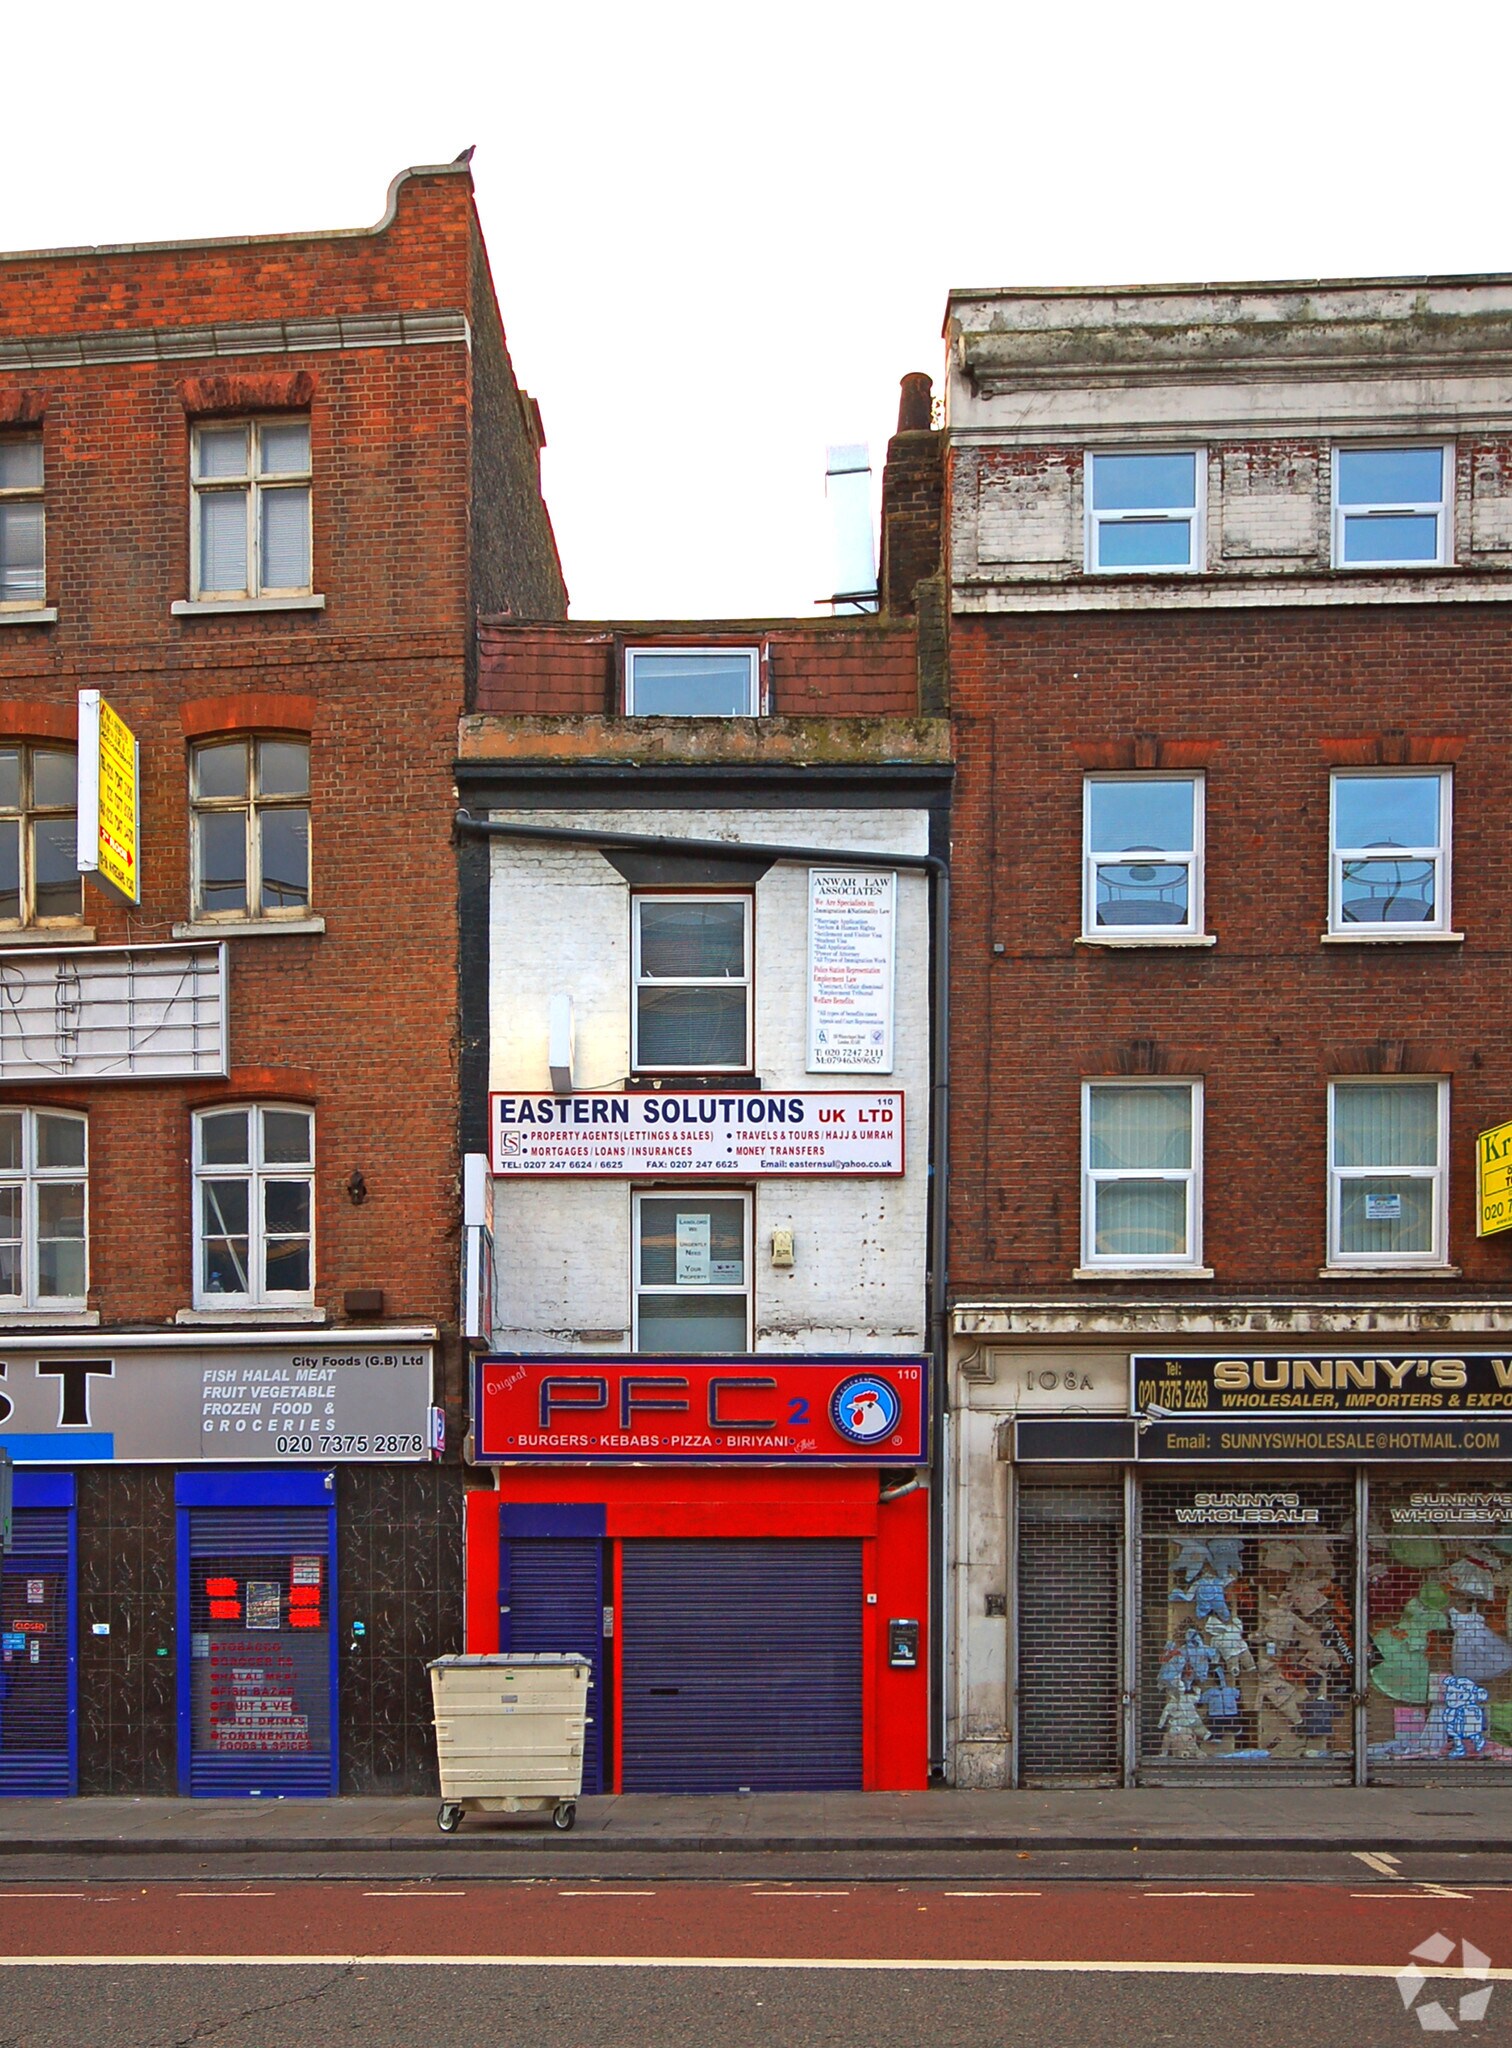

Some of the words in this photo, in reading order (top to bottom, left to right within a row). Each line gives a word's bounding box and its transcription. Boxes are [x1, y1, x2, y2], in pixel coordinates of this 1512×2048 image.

[814, 878, 856, 887] ANWAR
[865, 878, 890, 887] LAW
[819, 887, 883, 895] ASSOCIATES
[825, 1049, 840, 1057] 020
[842, 1049, 862, 1057] 7247
[864, 1049, 883, 1057] 2111
[878, 1098, 893, 1106] 110
[500, 1099, 629, 1123] EASTERN
[643, 1098, 805, 1123] SOLUTIONS
[818, 1109, 846, 1122] UK
[858, 1109, 893, 1122] LTD
[530, 1131, 580, 1141] PROPERTY
[672, 1131, 678, 1140] &
[680, 1131, 714, 1142] SALES)
[736, 1131, 778, 1140] TRAVELS
[780, 1131, 786, 1140] &
[851, 1131, 858, 1139] &
[860, 1130, 893, 1139] UMRAH
[735, 1146, 766, 1156] MONEY
[770, 1146, 825, 1156] TRANSFERS
[501, 1161, 521, 1169] TEL:
[523, 1161, 546, 1169] 0207
[549, 1161, 566, 1169] 247
[569, 1161, 592, 1169] 6624
[600, 1161, 623, 1169] 6625
[646, 1161, 667, 1169] FAX:
[670, 1161, 692, 1169] 0207
[695, 1161, 713, 1169] 247
[716, 1161, 739, 1169] 6625
[760, 1160, 787, 1168] Email:
[1484, 1201, 1504, 1220] 020
[292, 1356, 318, 1368] City
[322, 1356, 361, 1366] Foods
[365, 1355, 398, 1368] (G.B)
[402, 1355, 424, 1366] Ltd
[203, 1370, 236, 1382] FISH
[242, 1369, 290, 1382] HALAL
[295, 1369, 336, 1381] MEAT
[897, 1370, 918, 1380] 110
[1165, 1362, 1182, 1376] Tel:
[1213, 1359, 1468, 1391] SUNNY'S
[1026, 1370, 1094, 1391] 108A
[0, 1358, 116, 1428] T
[203, 1386, 247, 1398] FRUIT
[251, 1385, 336, 1398] VEGETABLE
[486, 1365, 527, 1396] Original
[539, 1375, 778, 1429] PFC
[787, 1396, 810, 1425] 2
[1138, 1380, 1157, 1408] 020
[1159, 1380, 1181, 1408] 7375
[1184, 1380, 1208, 1408] 2233
[1222, 1393, 1340, 1409] WHOLESALER,
[1345, 1393, 1443, 1407] IMPORTERS
[1447, 1393, 1460, 1407] &
[203, 1403, 261, 1415] FROZEN
[272, 1402, 312, 1415] FOOD
[324, 1402, 335, 1415] &
[203, 1419, 336, 1432] GROCERIES
[276, 1435, 312, 1453] 020
[319, 1435, 368, 1453] 7375
[374, 1434, 423, 1452] 2878
[518, 1435, 588, 1446] BURGERS
[600, 1435, 659, 1446] KEBABS
[671, 1435, 712, 1446] PIZZA
[726, 1436, 788, 1447] BIRIYANI
[1166, 1433, 1210, 1449] Email:
[1221, 1432, 1499, 1449] SUNNYSWHOLESALE@HOTMAIL.COM
[1194, 1493, 1299, 1507] SUNNY'S
[1410, 1492, 1512, 1507] SUNNY'S
[1175, 1509, 1319, 1523] WHOLESALE
[15, 1622, 45, 1631] CLOSED
[219, 1657, 294, 1667] GROCERES
[260, 1702, 268, 1711] &
[219, 1717, 254, 1726] COLD
[258, 1716, 305, 1726] DRINKS
[219, 1741, 257, 1751] FOODS
[261, 1741, 268, 1750] &
[272, 1741, 313, 1751] SPICES
